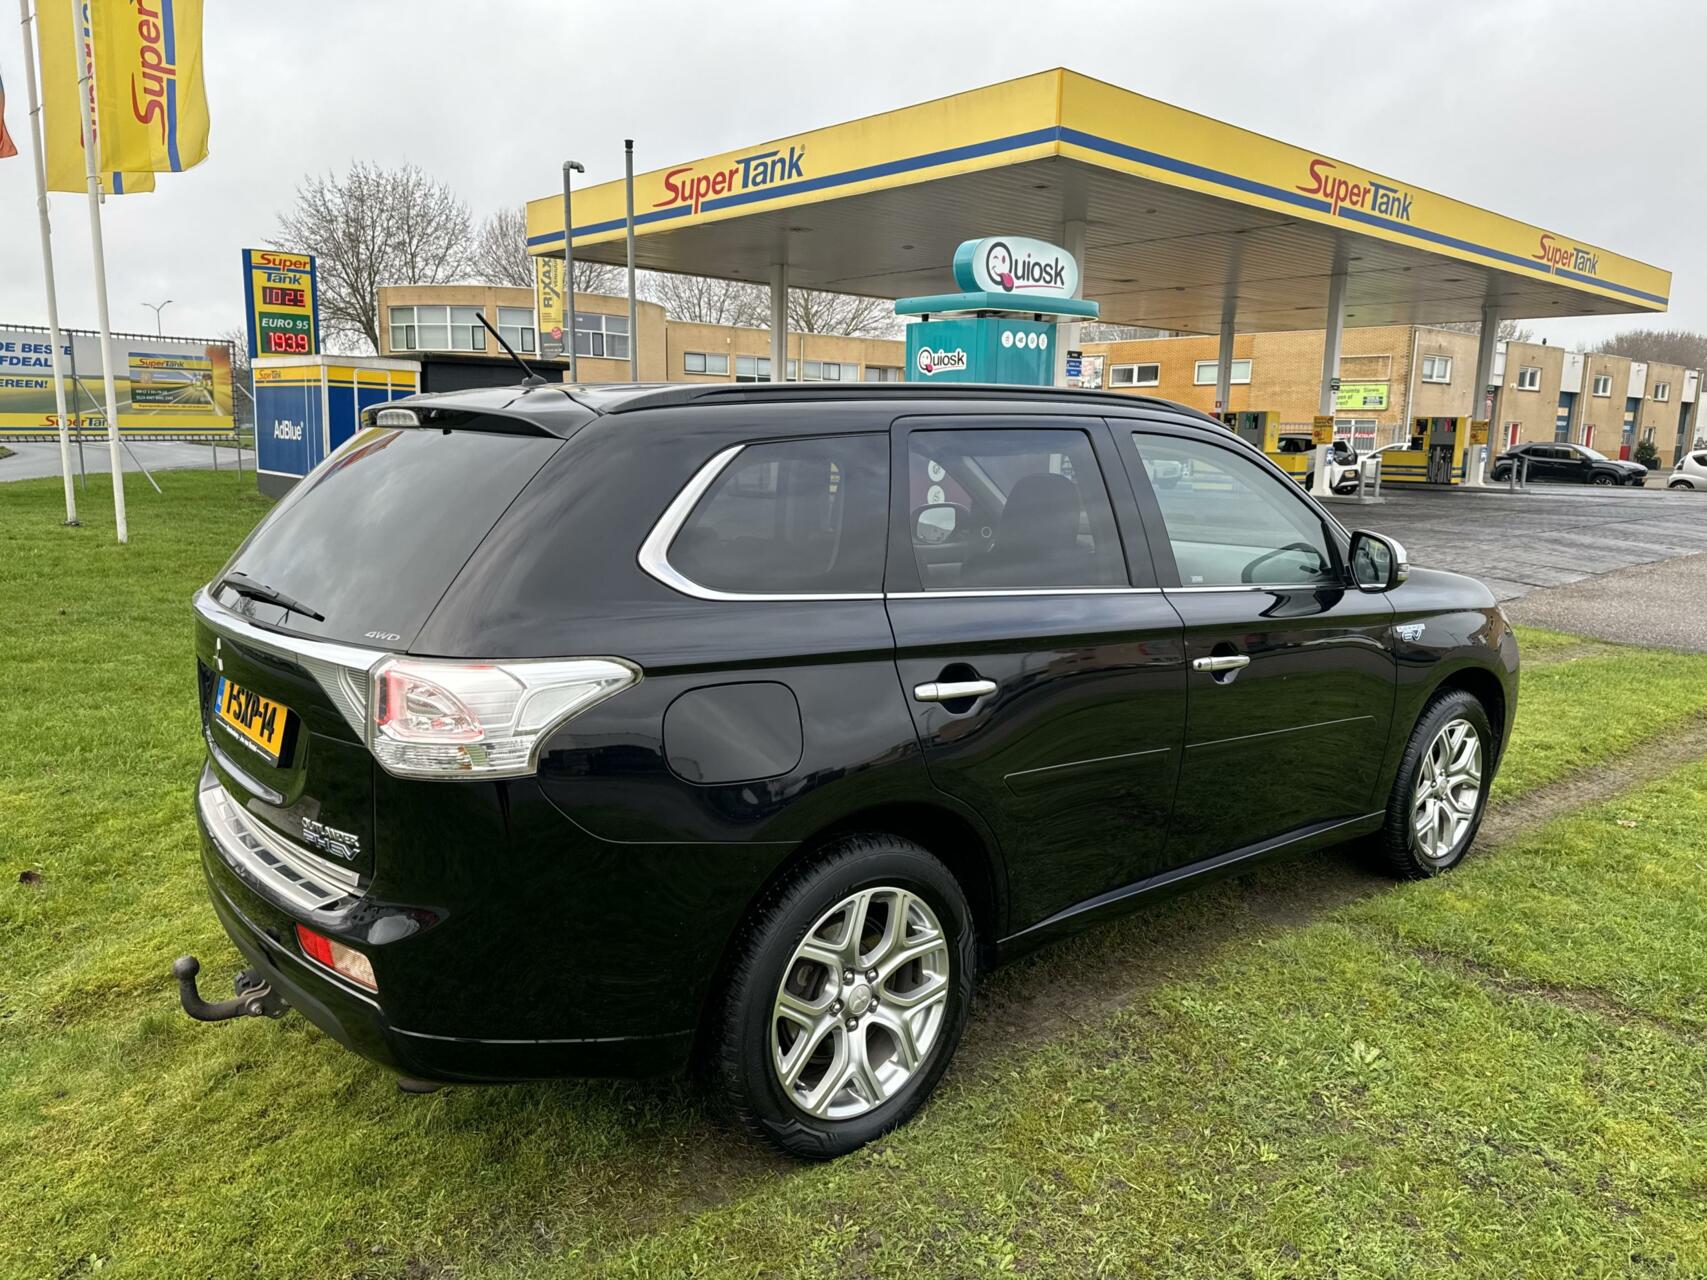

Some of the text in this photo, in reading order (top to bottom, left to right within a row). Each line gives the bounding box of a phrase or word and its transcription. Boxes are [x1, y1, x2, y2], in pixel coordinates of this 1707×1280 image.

[131, 0, 176, 147] Super
[653, 146, 805, 214] SuperTank
[1295, 159, 1412, 221] SuperTank
[253, 253, 309, 272] Super
[985, 241, 1064, 292] Quiosk
[1531, 234, 1598, 275] SuperTank
[263, 272, 301, 285] Tank
[261, 318, 309, 330] EURO 95
[21, 343, 72, 356] BESE
[918, 349, 965, 373] Quiosk
[273, 419, 303, 441] AdBlue
[364, 631, 401, 641] 4WD
[225, 682, 278, 744] 1-SXP-14
